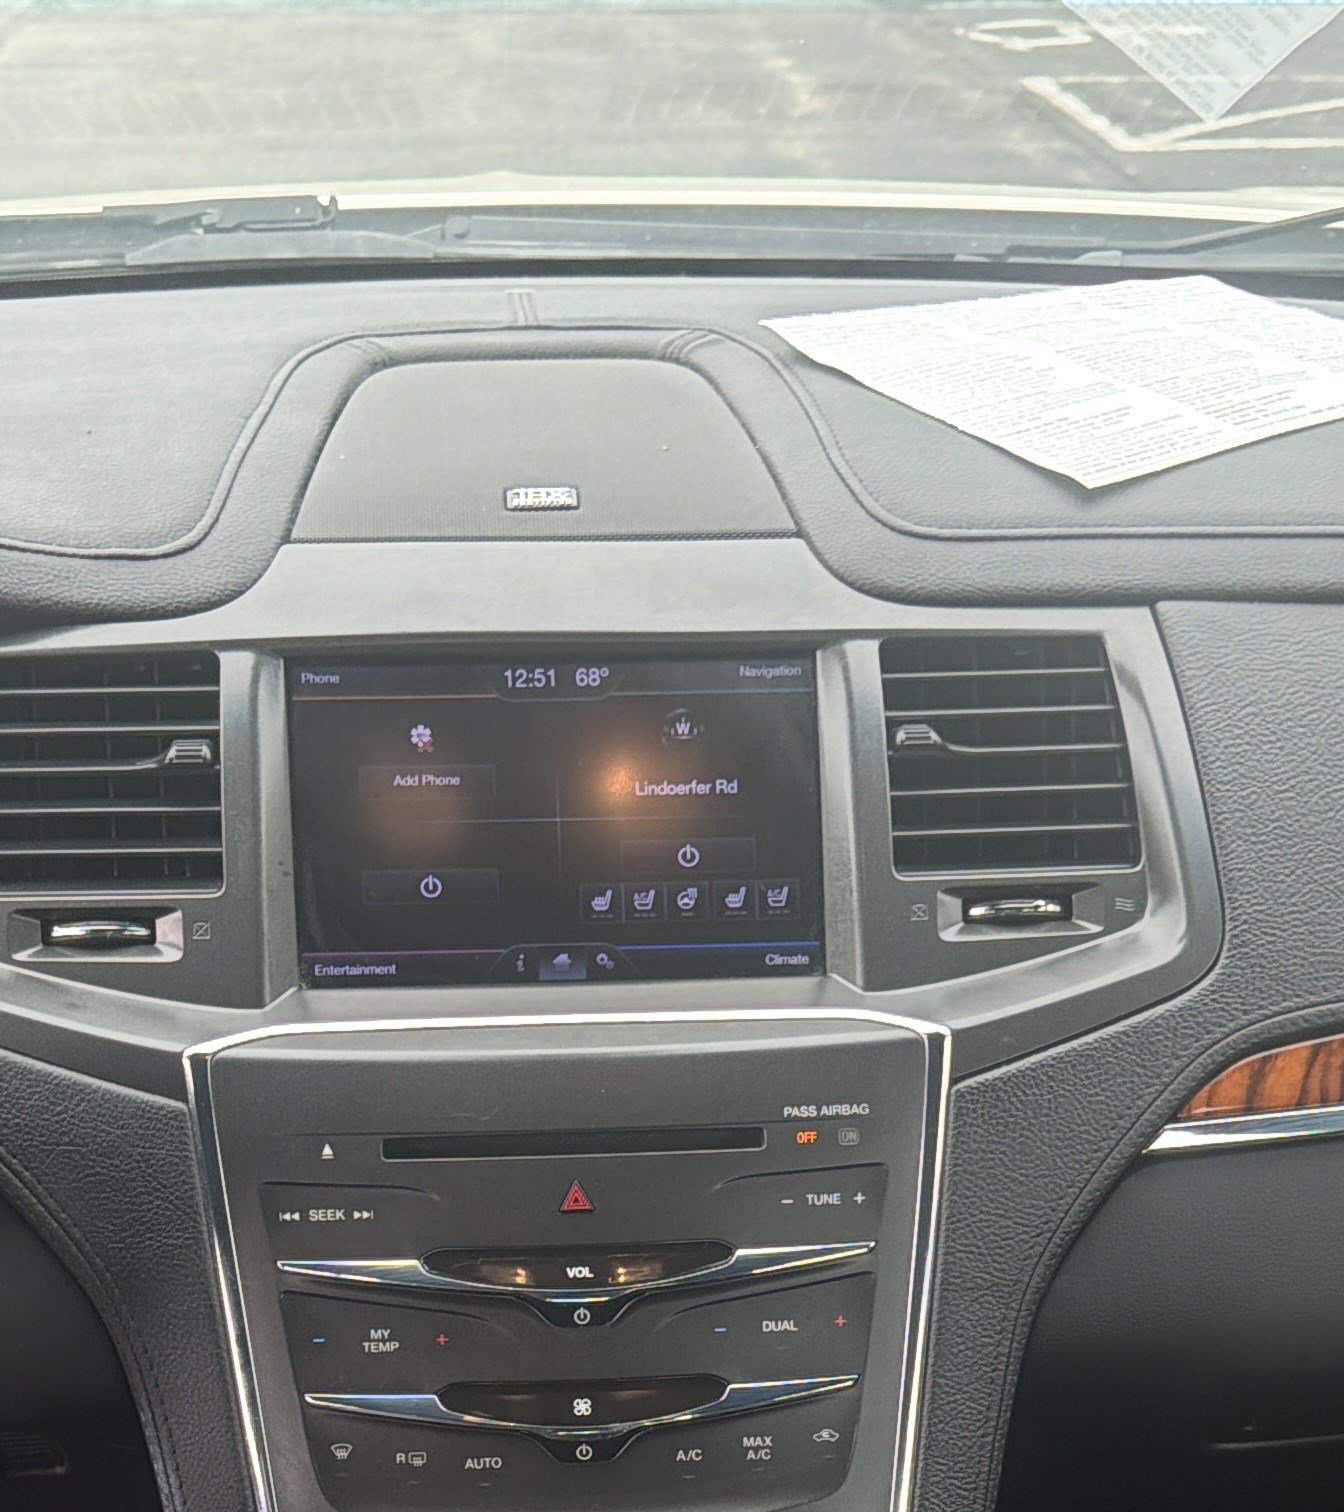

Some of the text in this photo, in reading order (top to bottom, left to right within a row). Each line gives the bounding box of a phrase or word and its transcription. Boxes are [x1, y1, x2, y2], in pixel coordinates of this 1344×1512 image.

[739, 664, 802, 678] Navigation
[301, 672, 340, 685] Phone
[503, 668, 556, 689] 12:51
[393, 774, 461, 786] Add Phone
[635, 779, 738, 796] Lindoerfer Rd
[765, 952, 810, 966] Climate
[314, 964, 397, 977] Entertainment
[783, 1103, 870, 1117] PASS AIRBAG
[796, 1131, 818, 1144] OFF
[805, 1192, 842, 1206] TUNE
[308, 1208, 346, 1222] SEEK
[565, 1266, 595, 1279] VOL
[762, 1320, 799, 1332] DUAL
[369, 1328, 391, 1340] MY
[361, 1341, 400, 1353] TEMP
[742, 1435, 773, 1448] MAX
[675, 1449, 704, 1462] A/C
[746, 1448, 772, 1461] A/C
[464, 1456, 503, 1470] AUTO
